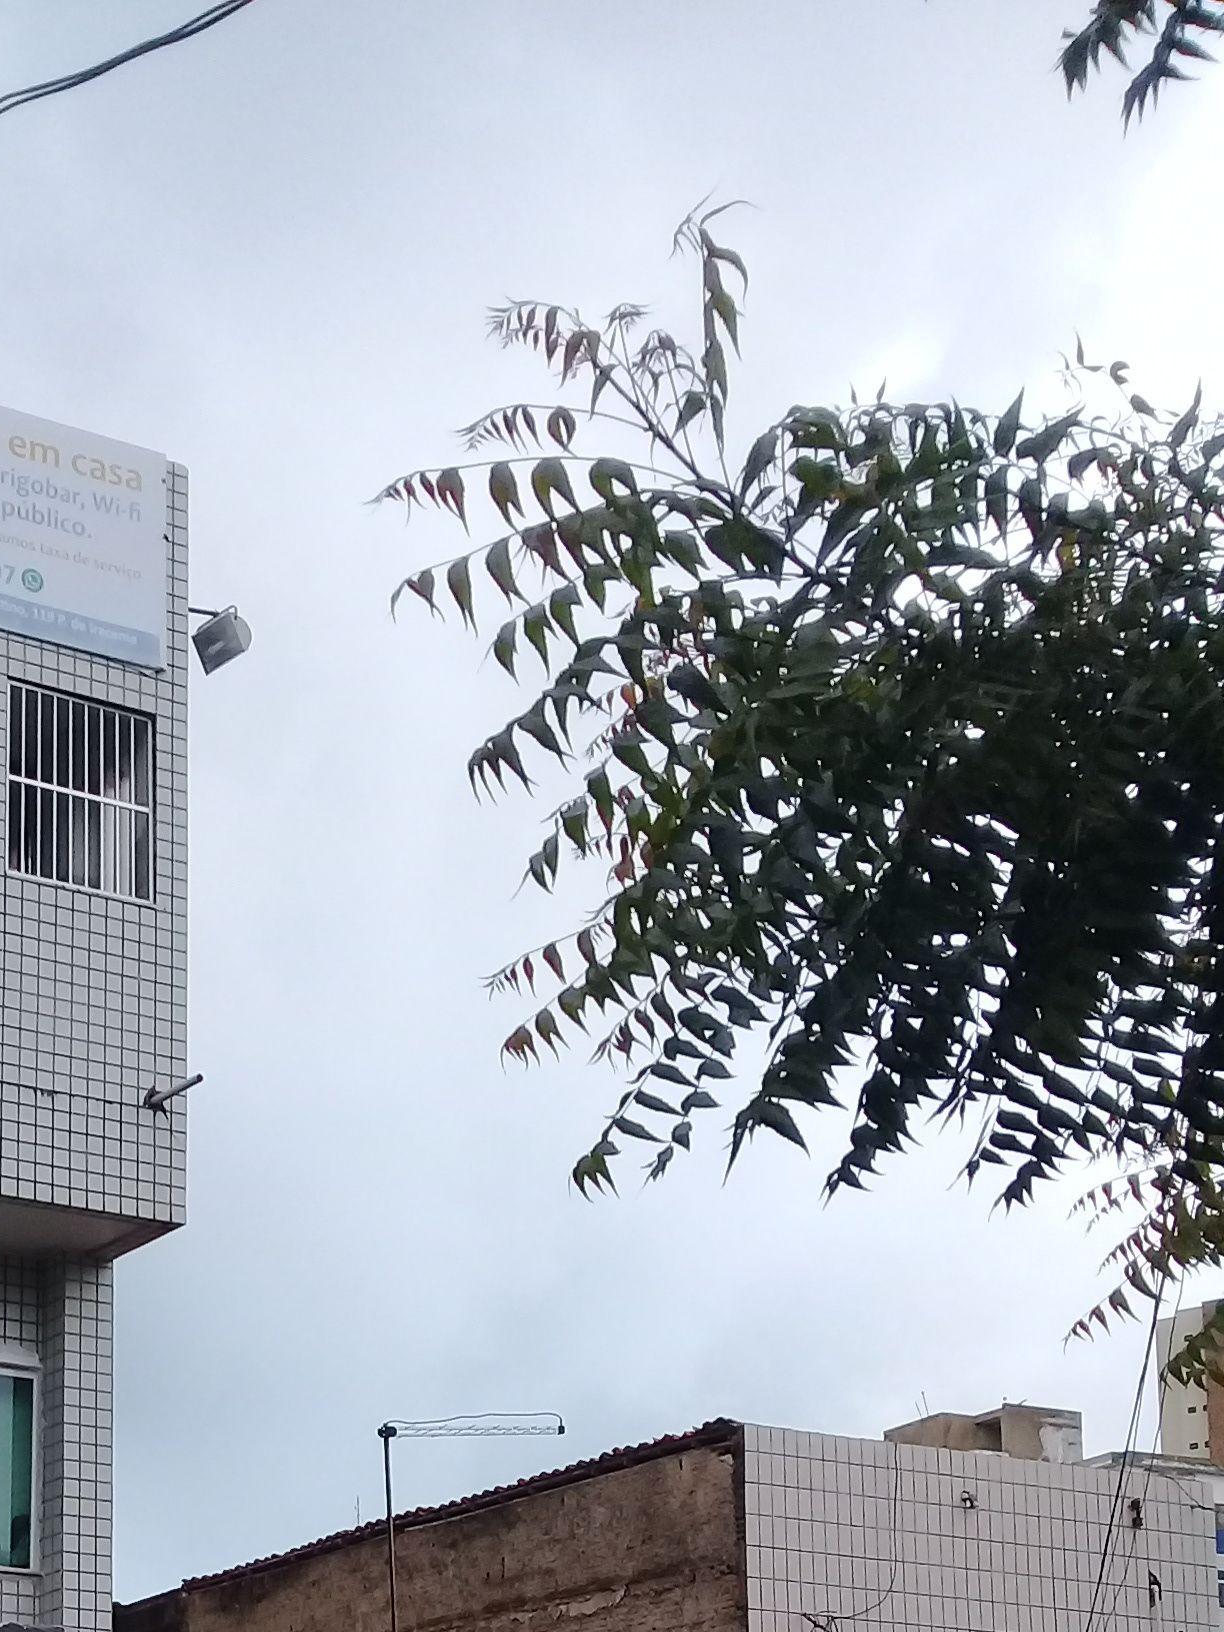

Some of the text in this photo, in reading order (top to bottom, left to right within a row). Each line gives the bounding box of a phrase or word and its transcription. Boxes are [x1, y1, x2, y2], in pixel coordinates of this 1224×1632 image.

[8, 434, 60, 468] em
[71, 451, 143, 492] casa
[1, 498, 93, 539] público.
[92, 490, 141, 523] Wi-fi
